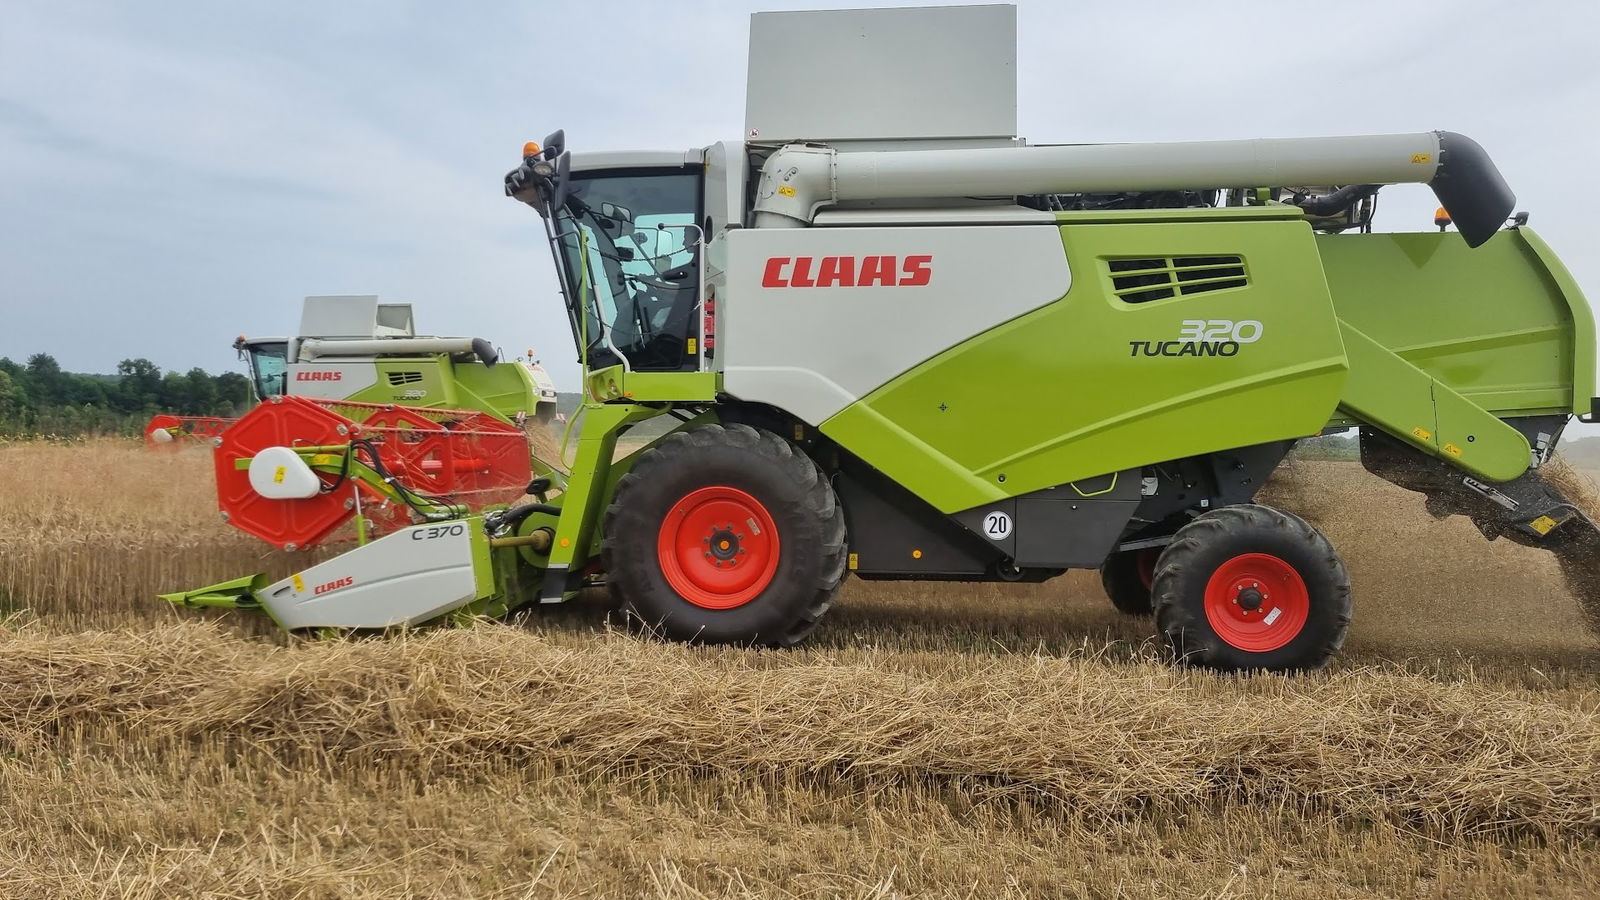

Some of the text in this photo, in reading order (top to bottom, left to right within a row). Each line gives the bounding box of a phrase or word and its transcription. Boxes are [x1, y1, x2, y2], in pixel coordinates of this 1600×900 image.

[761, 255, 933, 288] CLAAS
[1177, 319, 1264, 343] 320
[1129, 341, 1240, 357] TUCANO
[296, 371, 342, 381] CLAAS
[411, 525, 464, 541] C 370
[988, 516, 1007, 534] 20
[314, 576, 353, 595] CLAAS
